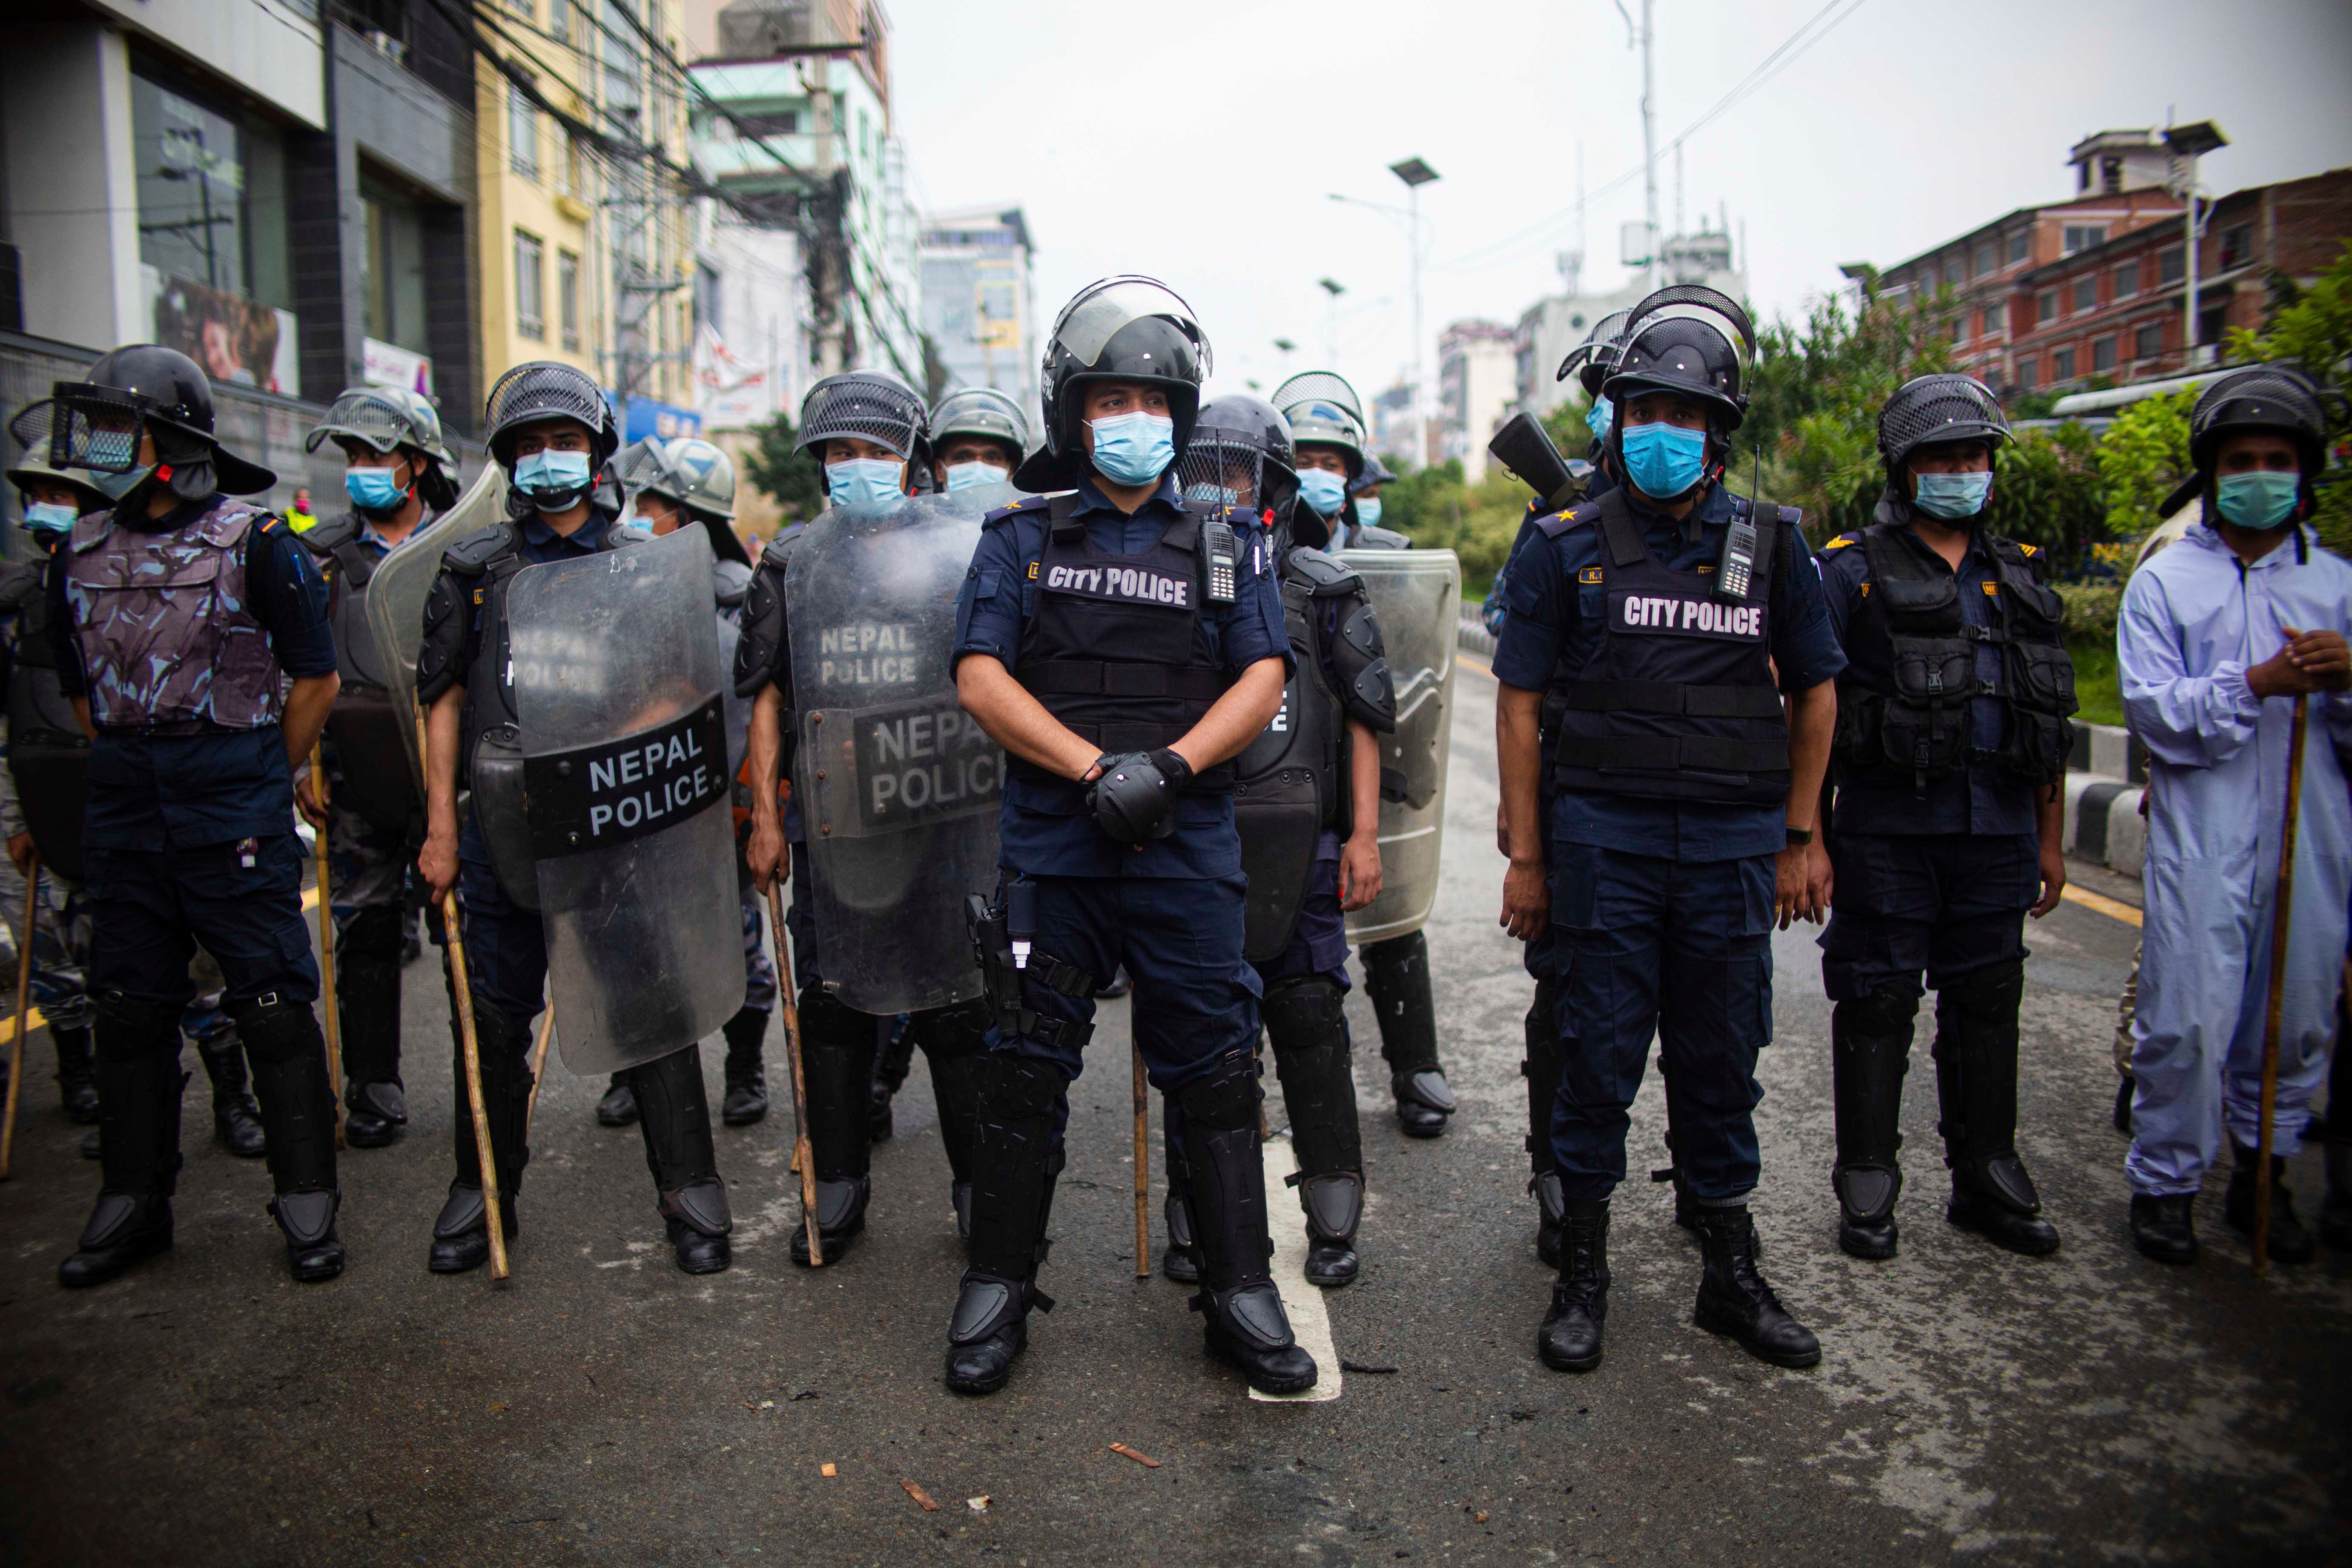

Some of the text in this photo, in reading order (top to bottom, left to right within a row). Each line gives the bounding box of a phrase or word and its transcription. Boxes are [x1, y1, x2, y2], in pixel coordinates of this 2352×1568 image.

[1048, 566, 1187, 605] CITY POLICE
[1624, 596, 1761, 636] CITY POLICE
[821, 625, 915, 654] NEPAL
[821, 657, 916, 685] POLICE
[877, 710, 989, 763] NEPA
[589, 728, 702, 793] NEPAL
[591, 764, 709, 837] POLICE
